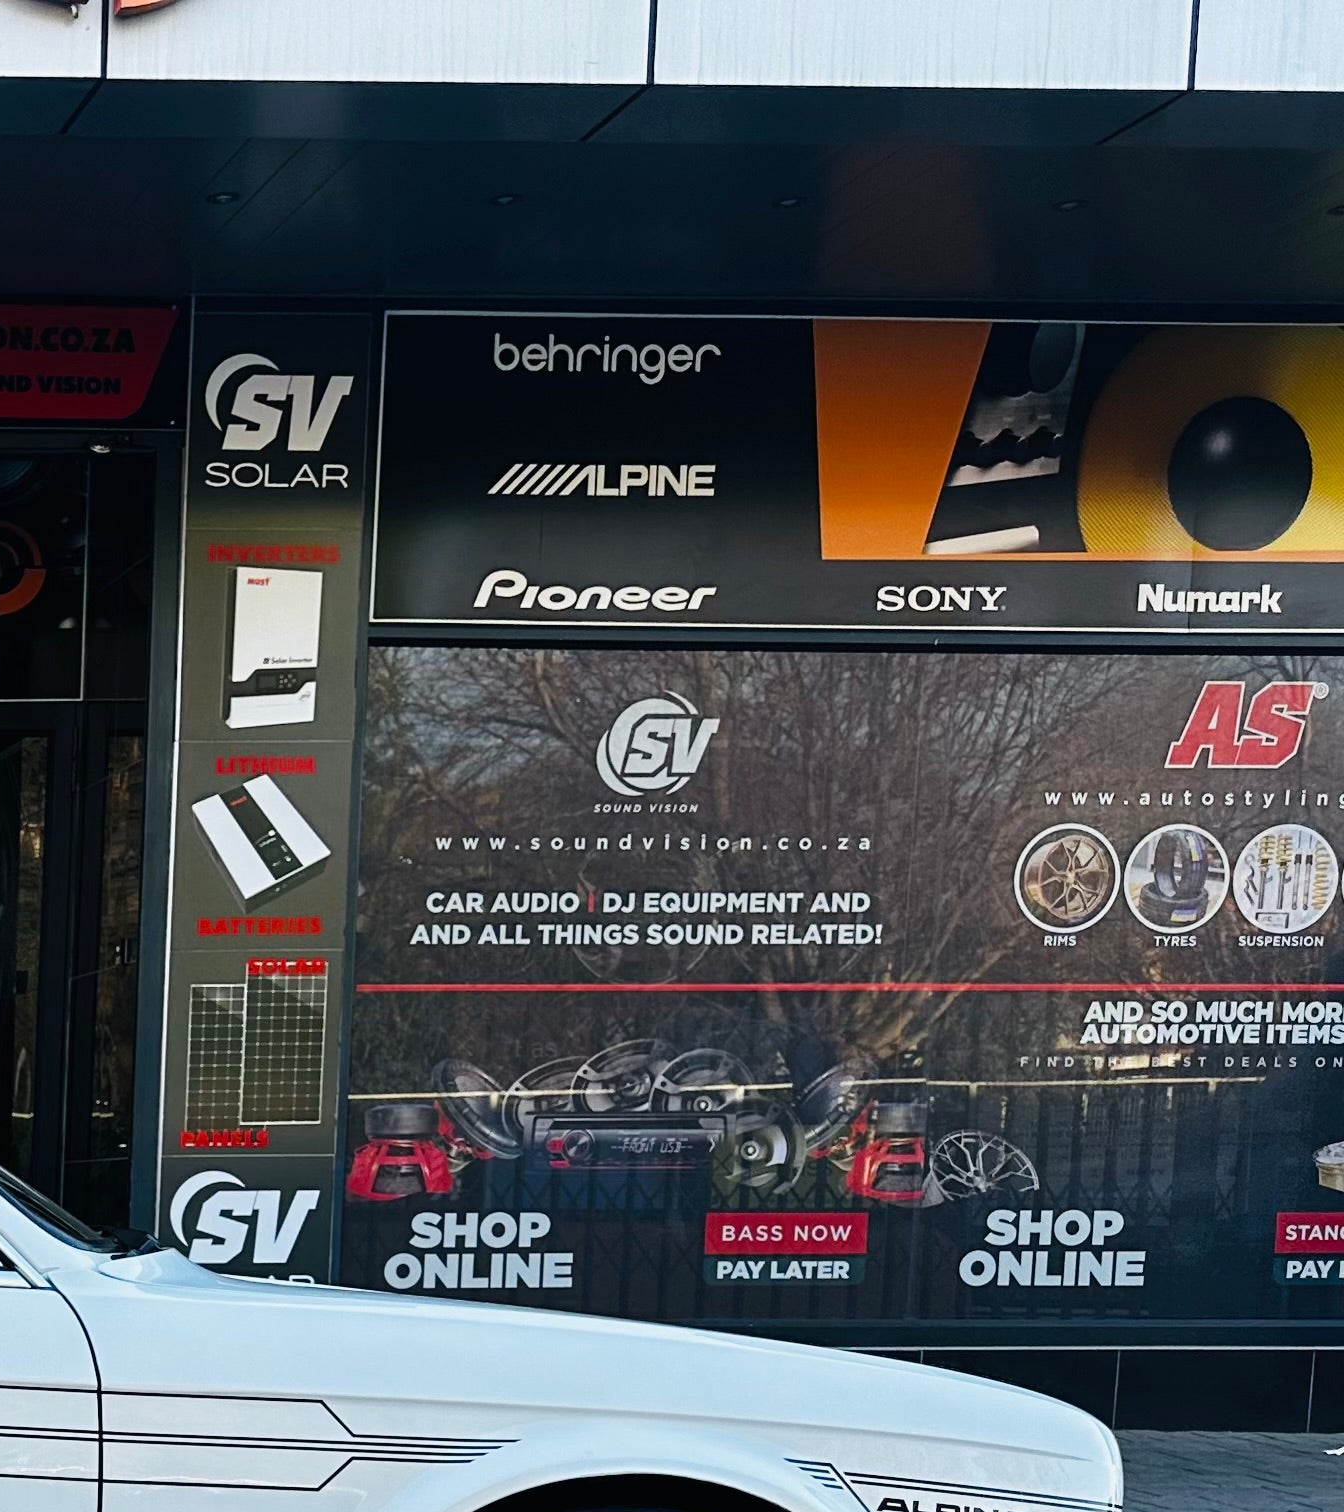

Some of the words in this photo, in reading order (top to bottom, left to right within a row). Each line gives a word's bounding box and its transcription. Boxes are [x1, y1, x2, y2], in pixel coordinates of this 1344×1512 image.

[493, 332, 722, 385] behringer
[38, 376, 121, 395] VISION
[221, 374, 355, 452] SV
[205, 462, 349, 489] SOLAR
[559, 463, 716, 497] ALPINE
[473, 569, 717, 611] Pioneer
[876, 586, 1008, 612] SONY
[1137, 583, 1282, 613] Numark
[215, 755, 316, 776] LITHIUM
[594, 803, 643, 814] SOUND
[649, 803, 700, 814] VISION
[435, 834, 872, 851] www.soundvision.co.za
[426, 892, 484, 914] CAR
[492, 892, 580, 914] AUDIO
[602, 892, 636, 914] DJ
[643, 892, 804, 914] EQUIPMENT
[809, 892, 871, 914] AND
[197, 916, 323, 937] BATTERIES
[409, 924, 471, 946] AND
[477, 924, 530, 946] ALL
[538, 924, 639, 946] THINGS
[645, 924, 744, 946] SOUND
[751, 924, 882, 946] RELATED!
[1043, 935, 1077, 947] RIMS
[1154, 935, 1197, 947] TYRES
[1238, 935, 1324, 947] SUSPENSION
[246, 957, 328, 976] SOLAR
[1084, 1001, 1144, 1024] AND
[1151, 1001, 1188, 1024] SO
[1196, 1001, 1274, 1024] MUCH
[1282, 1001, 1344, 1024] MOR
[1079, 1023, 1260, 1045] AUTOMOTIVE
[1266, 1023, 1344, 1045] ITEMS
[1020, 1056, 1075, 1068] FIND
[1224, 1056, 1298, 1068] DEALS
[179, 1130, 270, 1149] PANELS
[189, 1190, 320, 1264] SV
[409, 1211, 552, 1249] SHOP
[721, 1224, 784, 1242] BASS
[793, 1224, 853, 1242] NOW
[984, 1209, 1125, 1246] SHOP
[383, 1252, 574, 1290] ONLINE
[716, 1260, 768, 1280] PAY
[770, 1260, 850, 1280] LATER
[958, 1250, 1146, 1287] ONLINE
[1285, 1260, 1335, 1279] PAY
